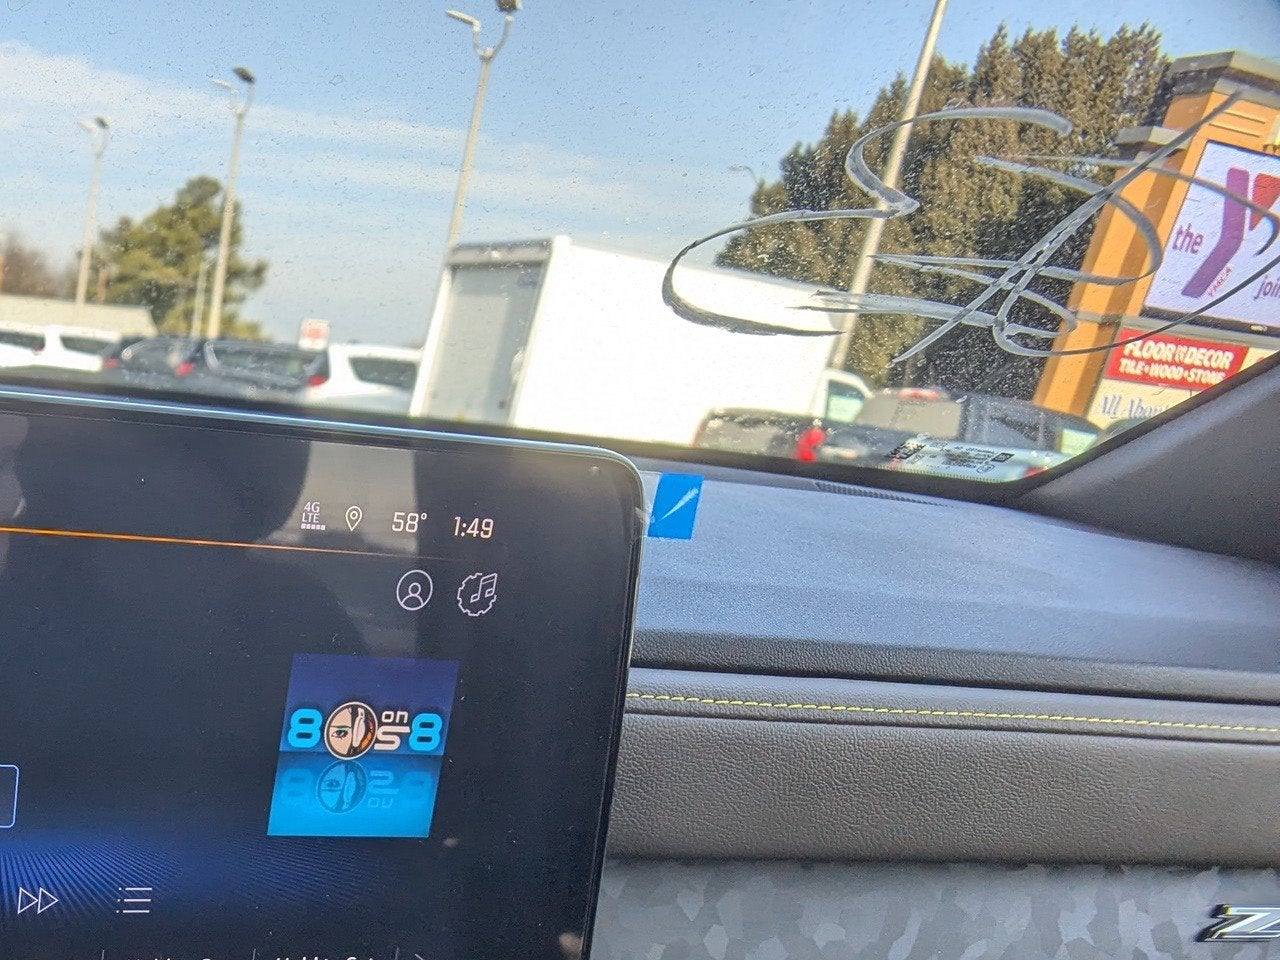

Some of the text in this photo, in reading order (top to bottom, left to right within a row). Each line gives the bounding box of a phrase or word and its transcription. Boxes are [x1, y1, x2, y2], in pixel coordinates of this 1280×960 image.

[1172, 224, 1204, 254] the
[1123, 337, 1175, 362] FLOOR
[1186, 345, 1234, 370] DECOR
[302, 512, 320, 524] LTE
[304, 501, 320, 513] 4G
[391, 511, 428, 533] 58°
[453, 516, 494, 539] 1:49
